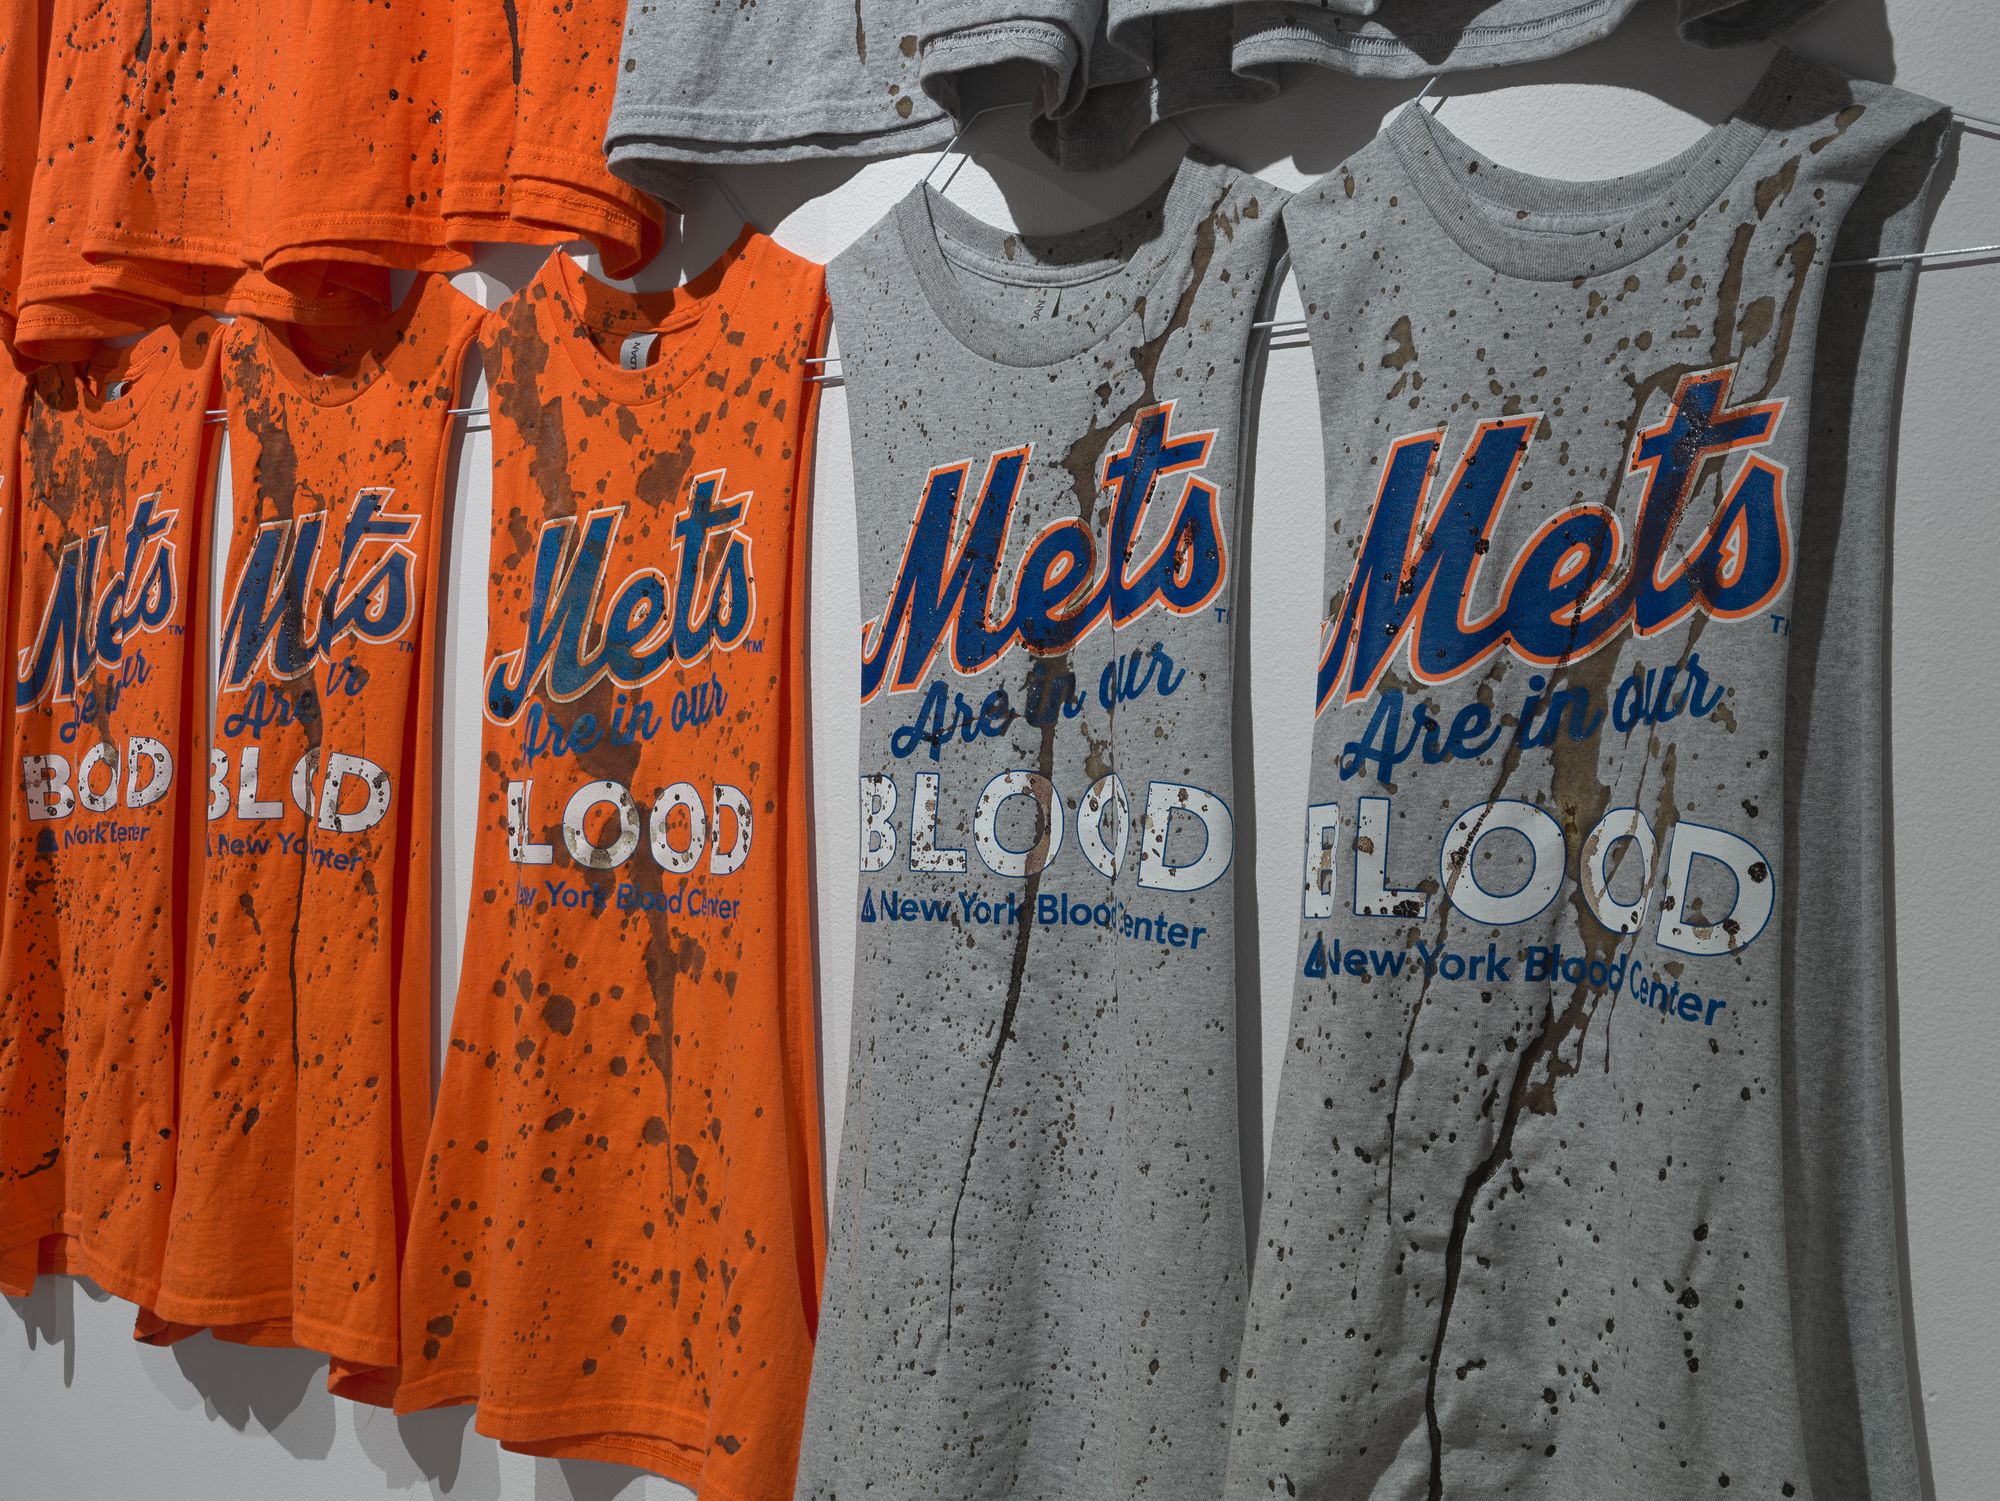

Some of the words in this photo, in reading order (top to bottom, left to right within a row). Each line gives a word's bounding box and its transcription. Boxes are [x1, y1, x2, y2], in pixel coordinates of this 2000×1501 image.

[218, 487, 421, 693] Mts
[481, 468, 757, 726] Mets
[860, 399, 1233, 705] Mets
[1314, 363, 1790, 719] Mets
[610, 693, 663, 746] in
[671, 672, 729, 733] our
[891, 680, 1013, 763] Are
[1339, 687, 1501, 785] Are
[1517, 674, 1603, 750] in
[1611, 652, 1725, 733] our
[860, 769, 1234, 892] BLOOD
[544, 880, 608, 909] York
[616, 883, 684, 914] Blood
[687, 886, 741, 919] Center
[880, 890, 951, 923] New
[957, 891, 1026, 926] York
[1416, 942, 1511, 983] York
[1524, 944, 1628, 991] Blood
[1629, 959, 1727, 1027] Center
